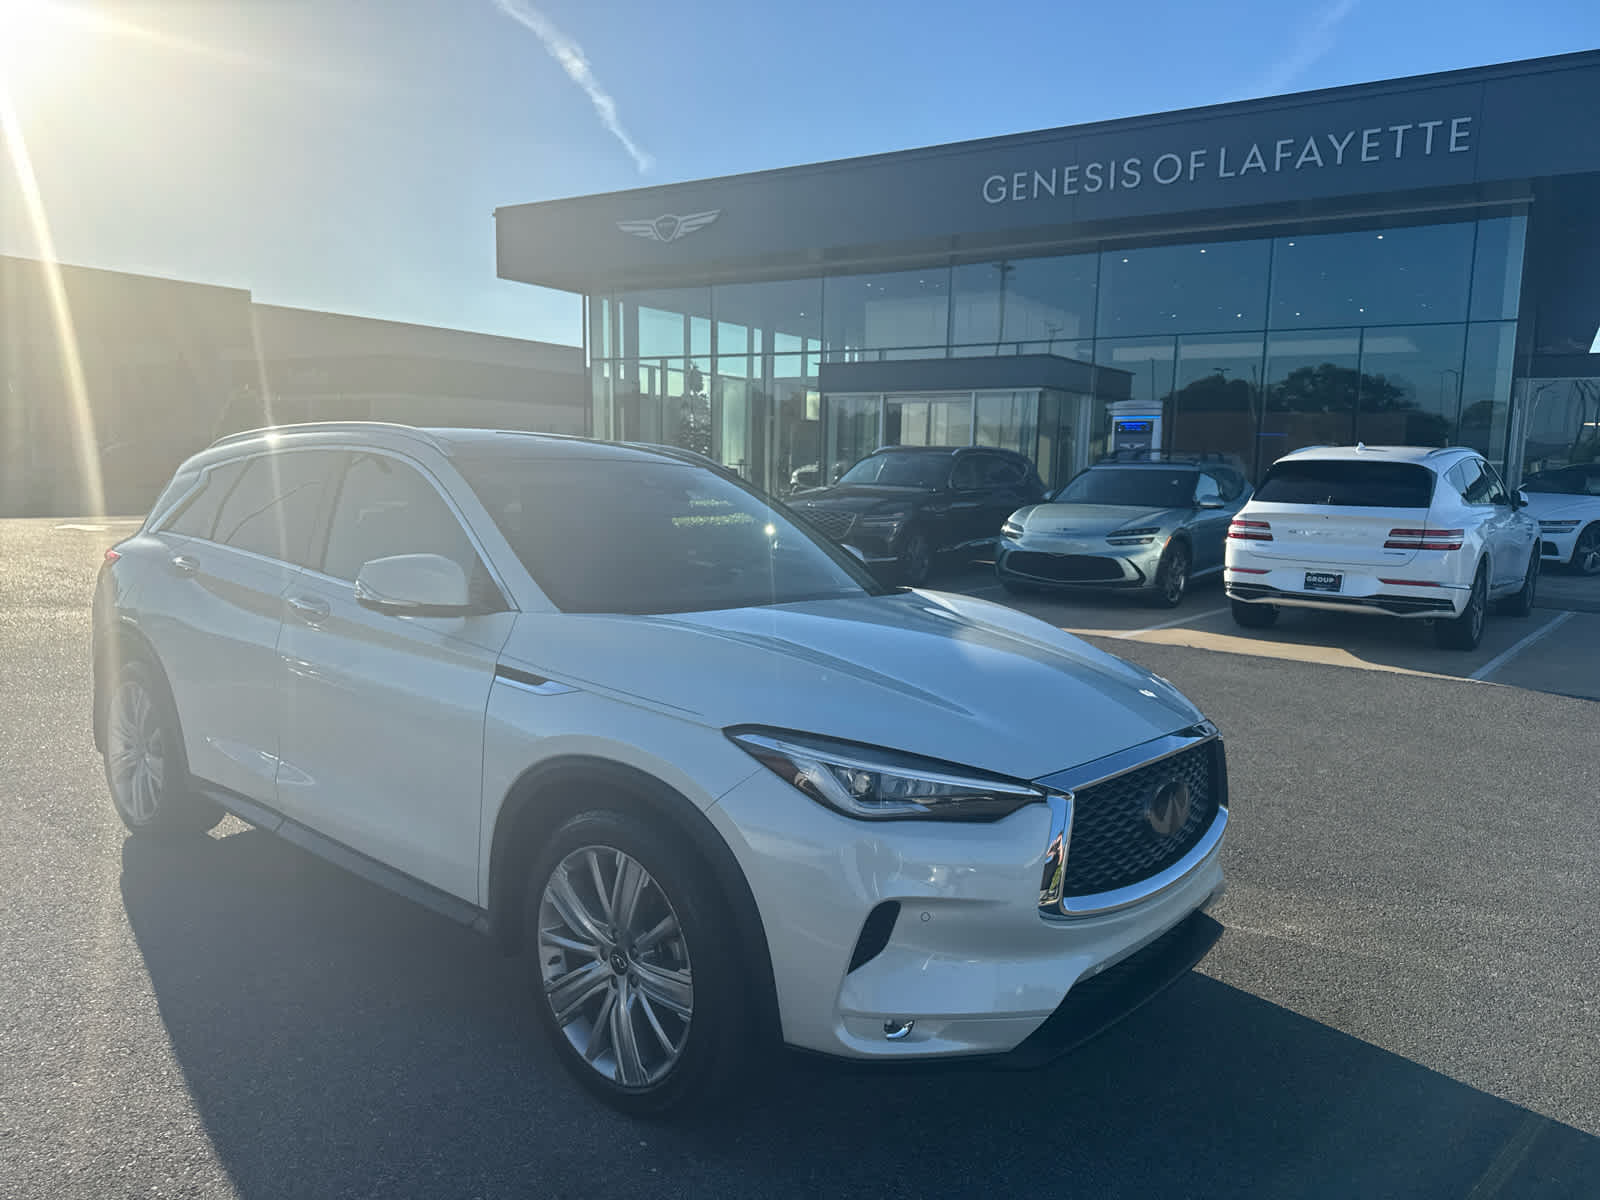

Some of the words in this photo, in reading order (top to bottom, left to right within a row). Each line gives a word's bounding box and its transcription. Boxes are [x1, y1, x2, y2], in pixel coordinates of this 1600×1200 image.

[983, 158, 1141, 204] GENESIS
[1153, 150, 1207, 184] OF
[1219, 117, 1472, 178] LAFAYETTE
[1306, 575, 1335, 584] GROUP
